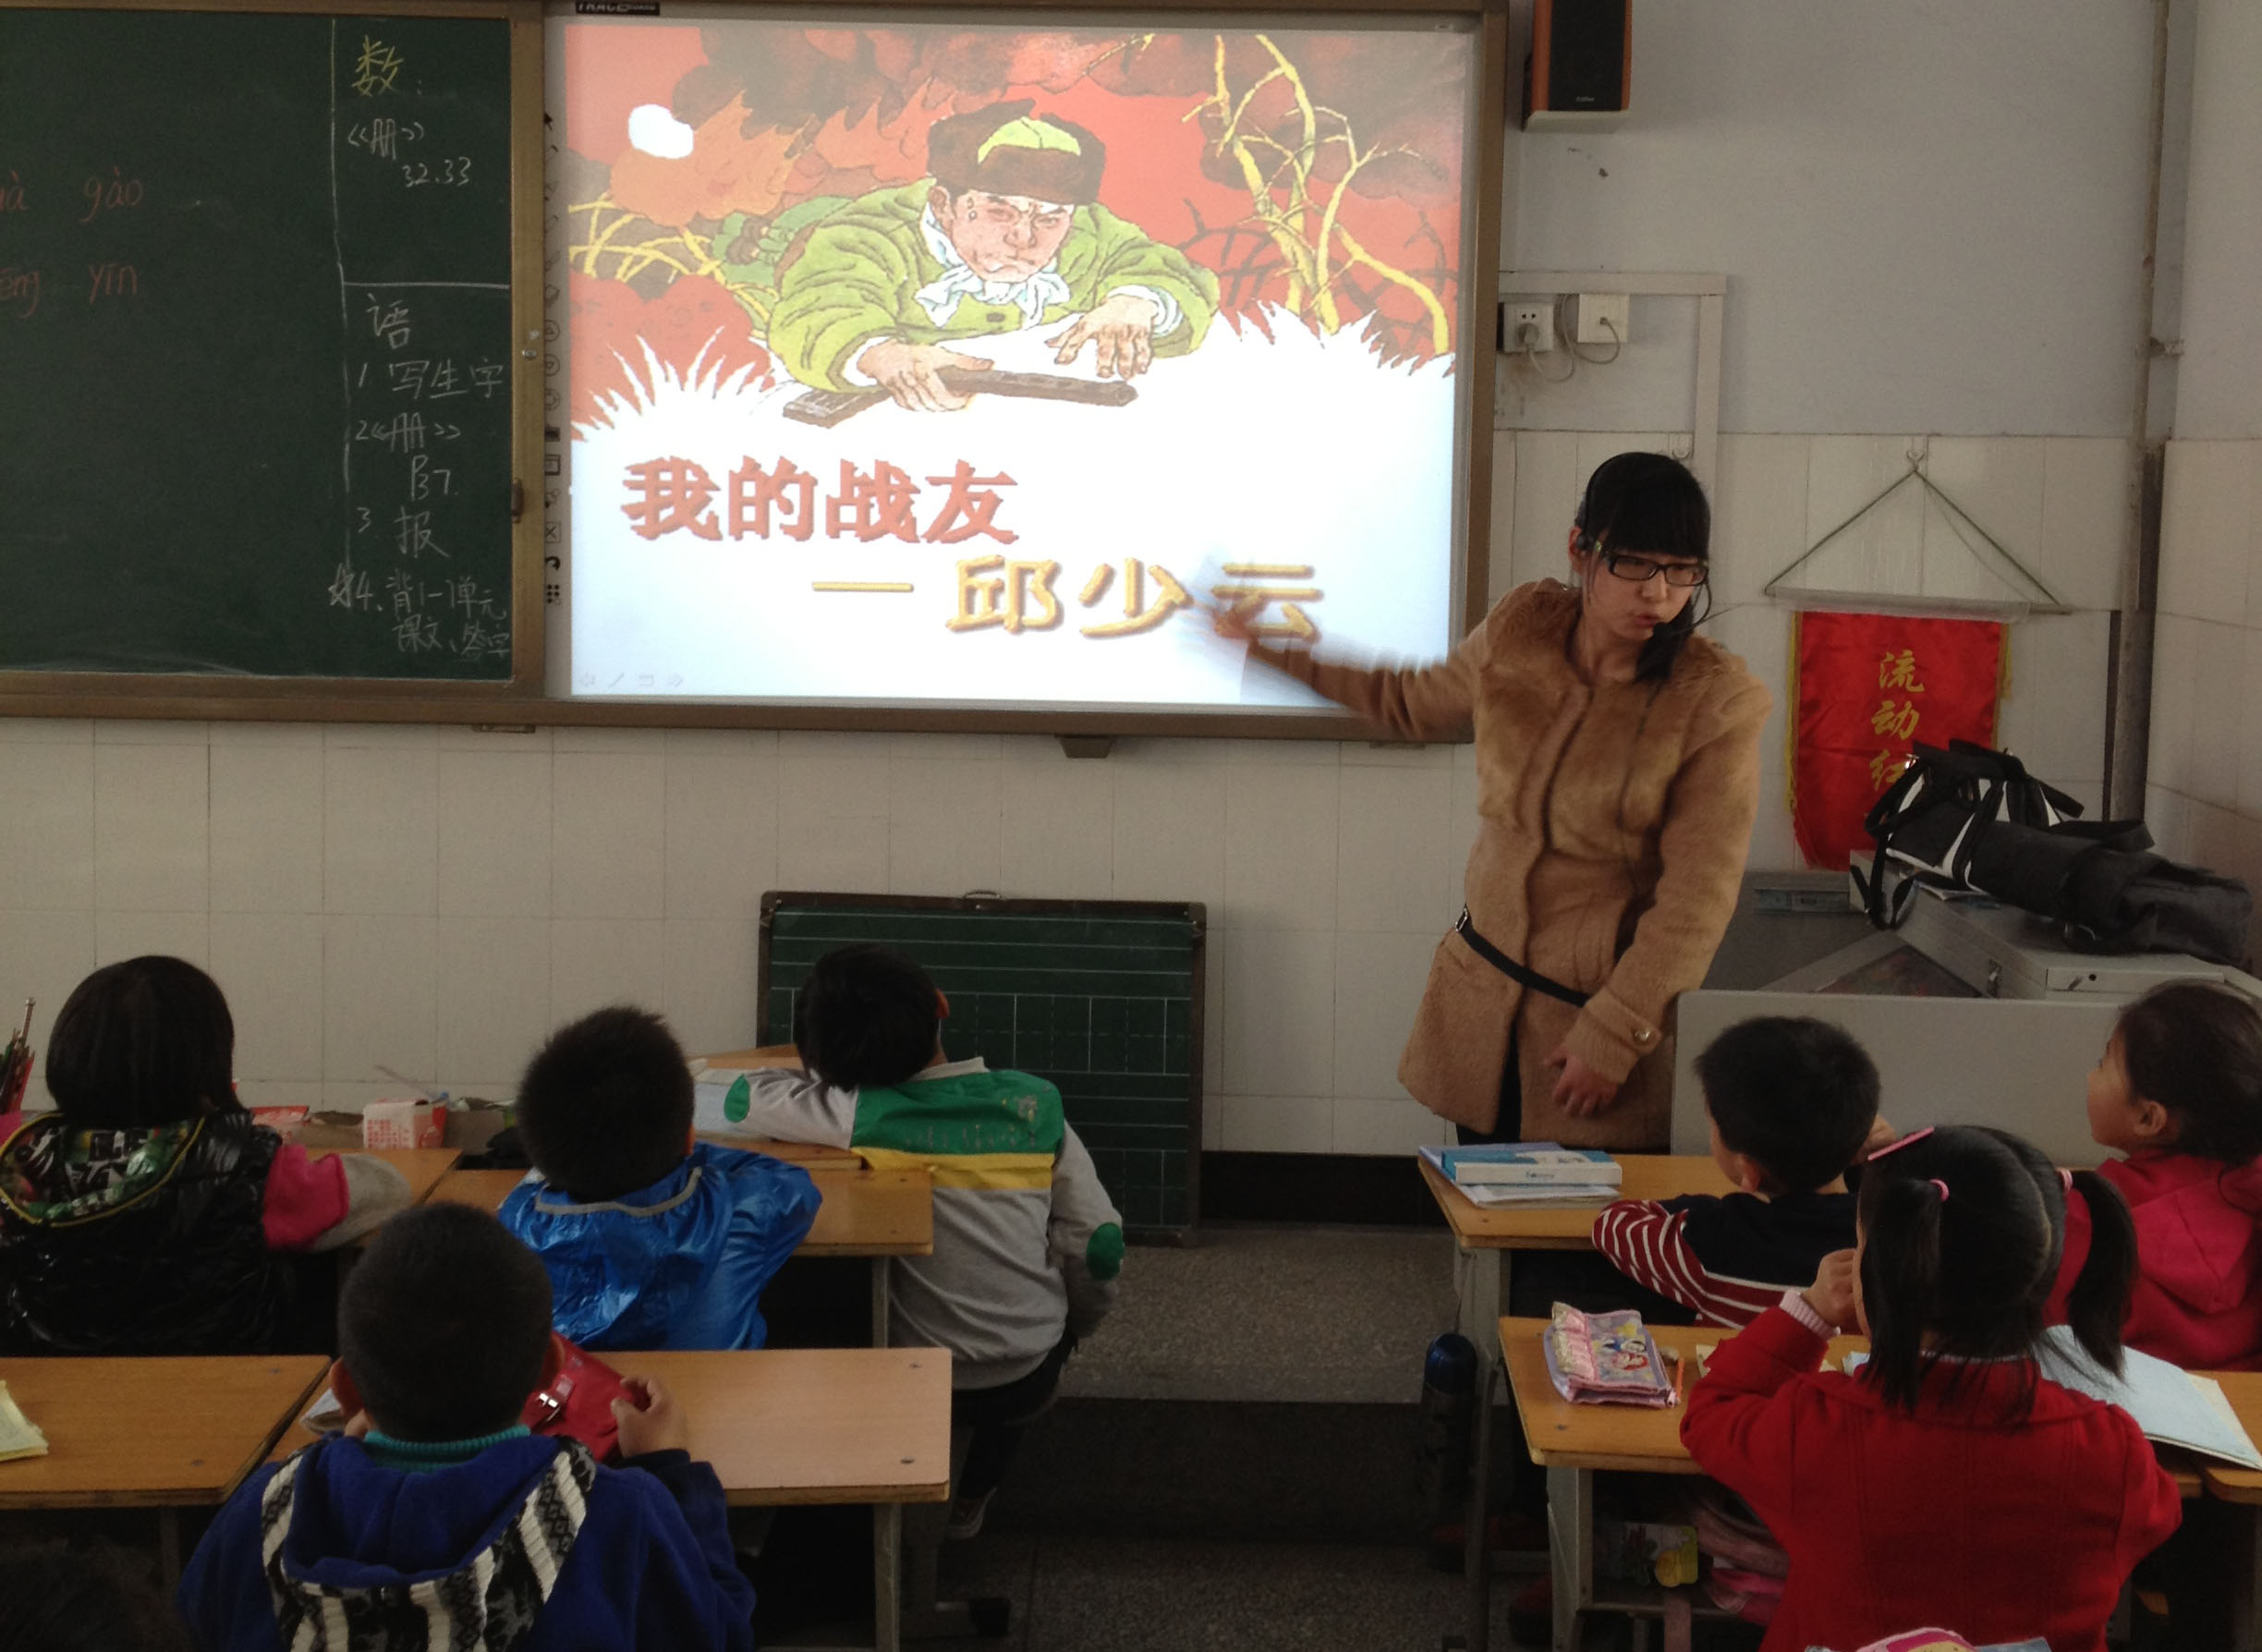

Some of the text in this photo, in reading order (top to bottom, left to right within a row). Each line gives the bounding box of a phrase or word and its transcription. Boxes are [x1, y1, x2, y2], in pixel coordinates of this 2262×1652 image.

[367, 294, 412, 349] 语
[389, 358, 503, 399] 写生字
[395, 504, 450, 558] 报
[621, 456, 1019, 544] 我的战友
[945, 554, 1321, 643] 邱少云
[1869, 650, 1925, 791] 流动红
